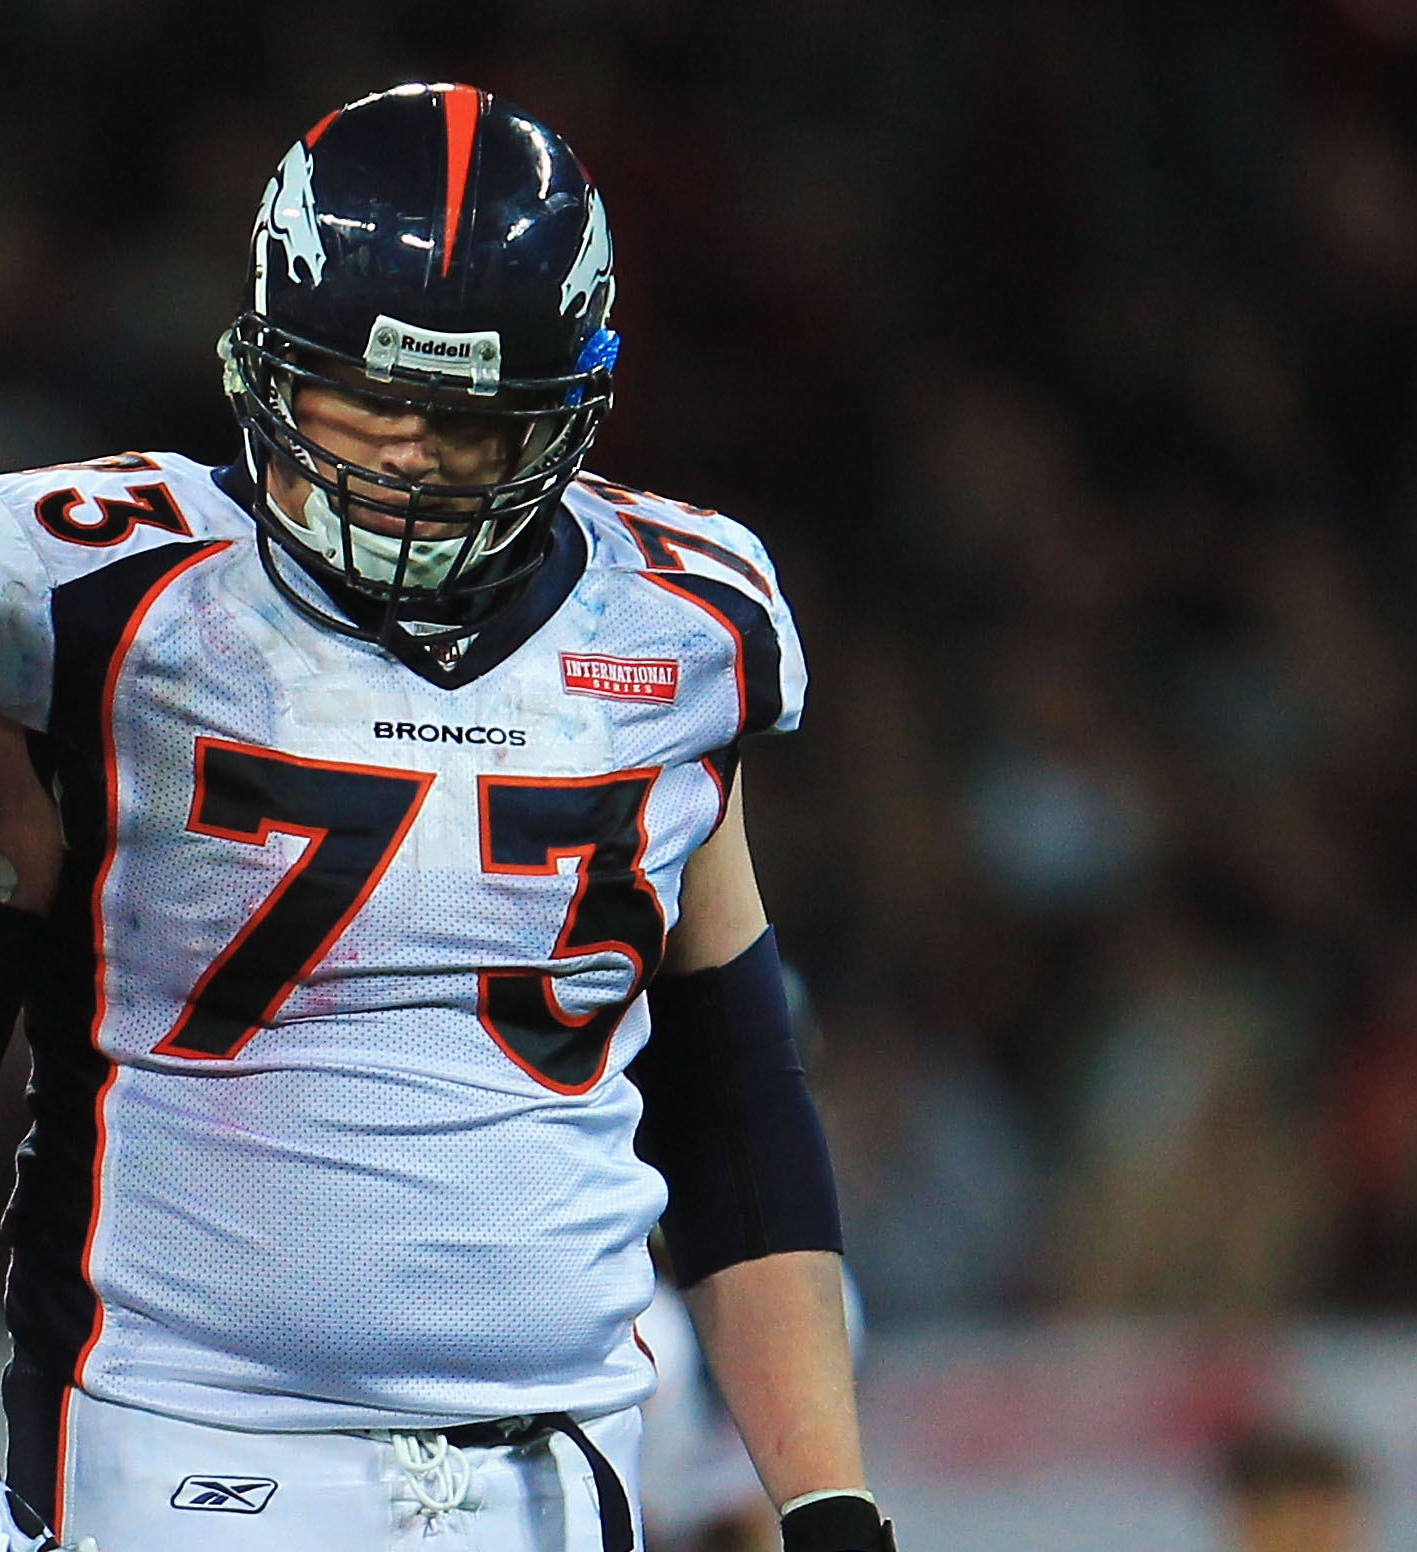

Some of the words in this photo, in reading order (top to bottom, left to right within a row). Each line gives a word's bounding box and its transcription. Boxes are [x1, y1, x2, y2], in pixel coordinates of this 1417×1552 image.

[401, 335, 470, 358] Riddell
[565, 660, 674, 685] INTERNATIONAL
[592, 679, 652, 694] SERIES
[373, 720, 526, 746] BRONCOS
[150, 735, 668, 1096] 73
